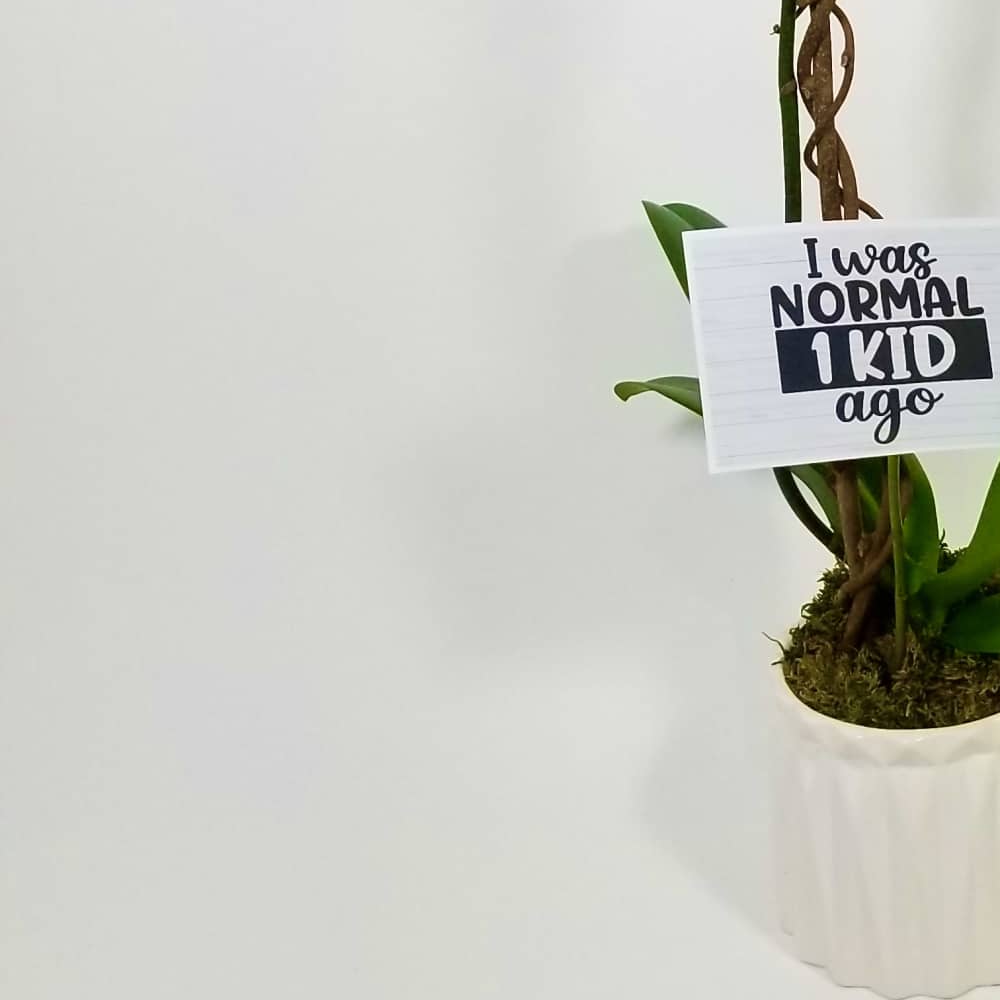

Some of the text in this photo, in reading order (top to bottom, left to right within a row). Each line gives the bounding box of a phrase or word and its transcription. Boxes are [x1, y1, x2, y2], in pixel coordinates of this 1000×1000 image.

[803, 238, 938, 280] I was
[770, 276, 985, 328] NORMAL
[811, 325, 956, 384] 1 KID
[835, 387, 945, 444] ago
